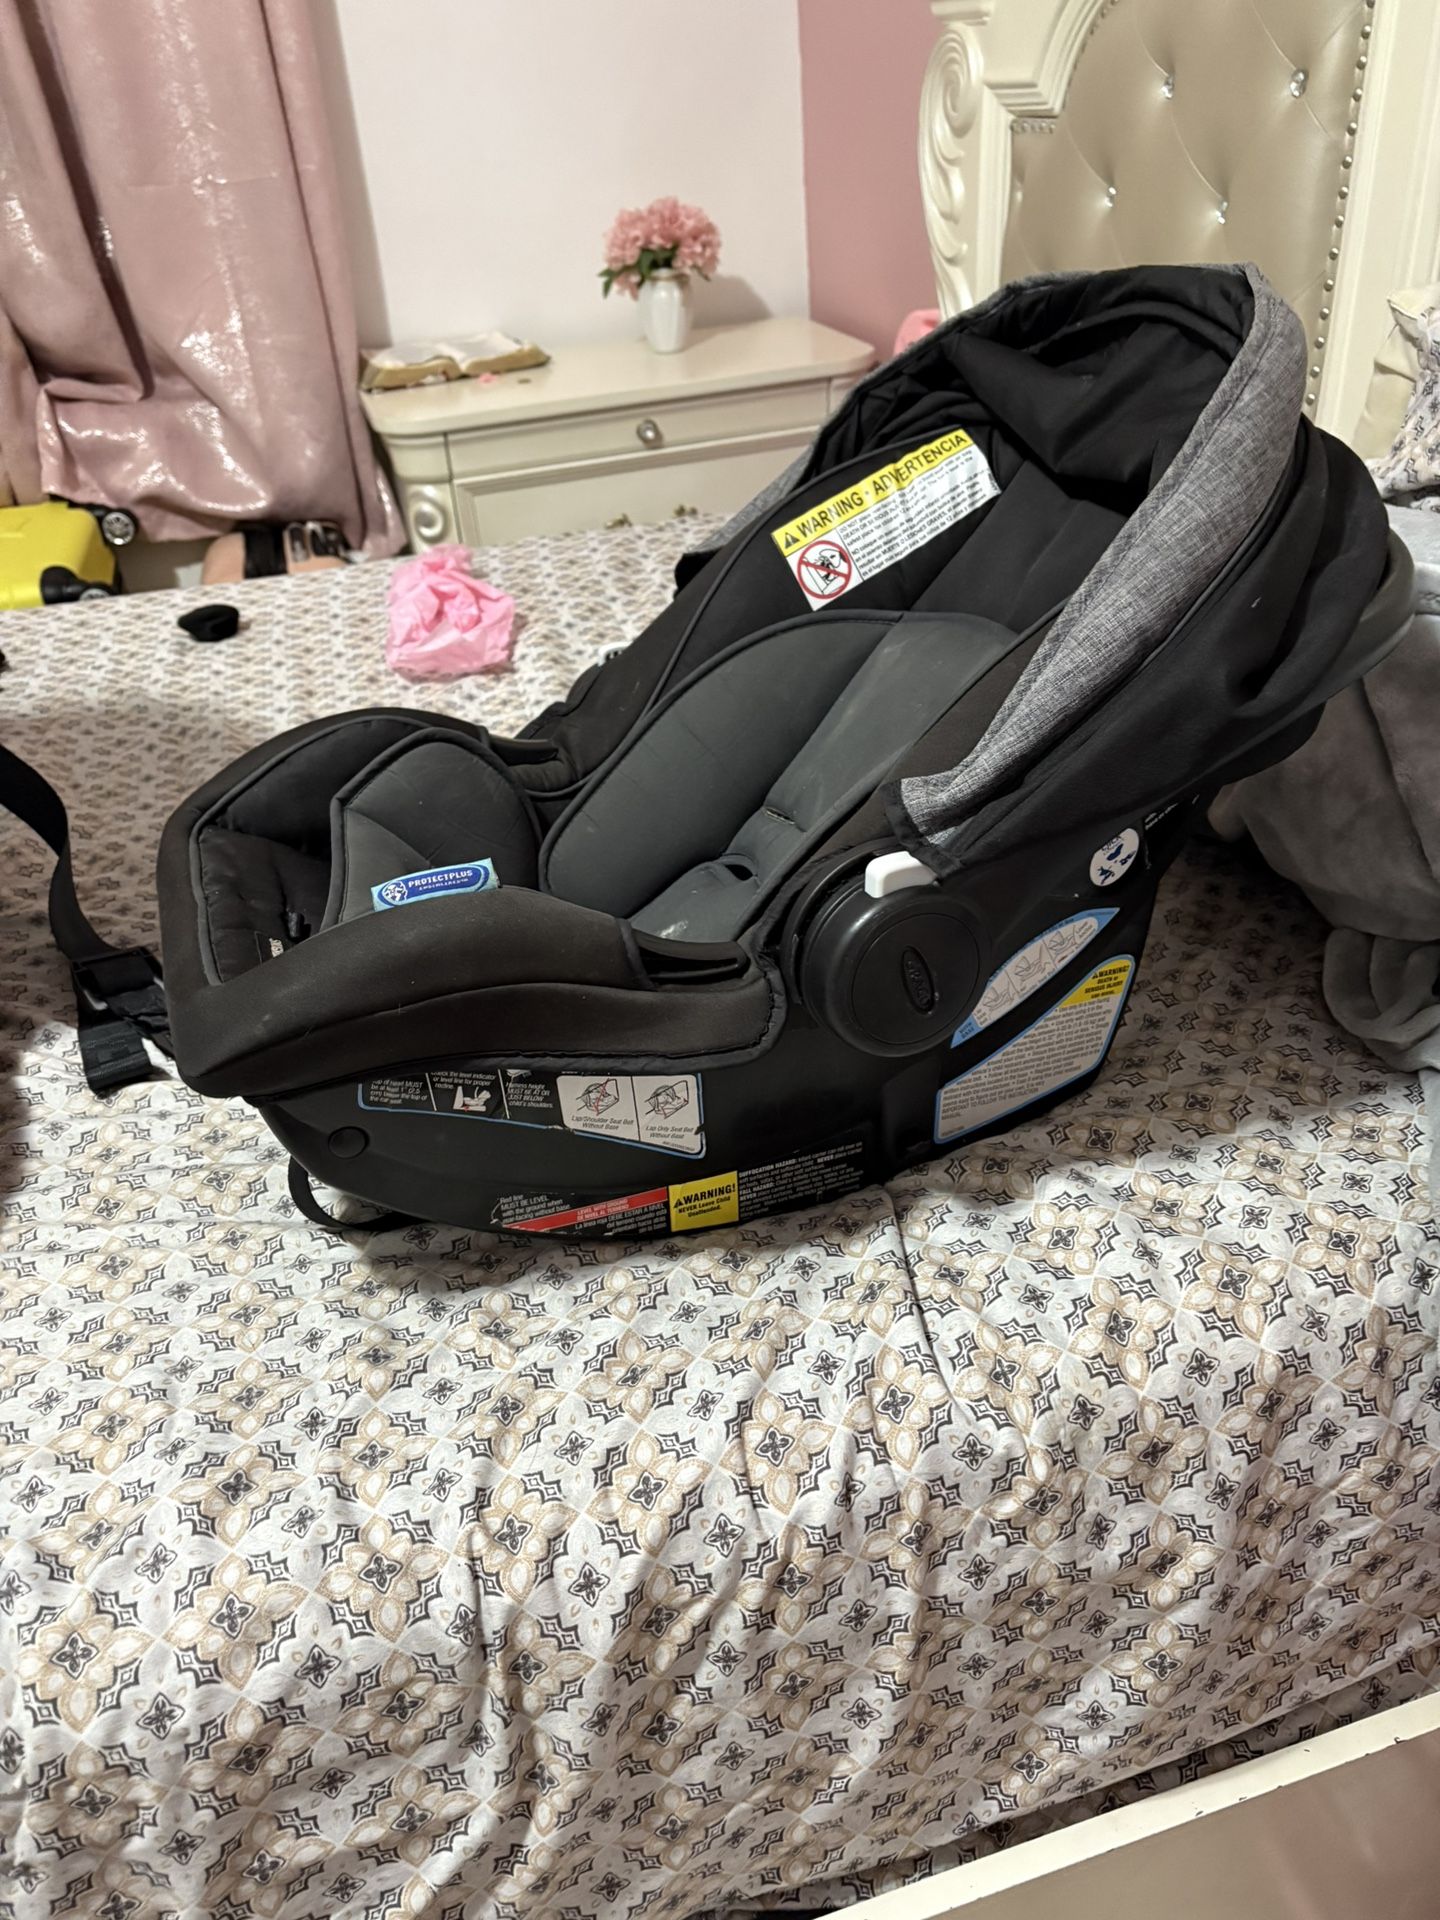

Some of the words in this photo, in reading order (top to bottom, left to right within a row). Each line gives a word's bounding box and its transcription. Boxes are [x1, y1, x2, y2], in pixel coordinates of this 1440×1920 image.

[796, 490, 864, 538] WARNING
[873, 433, 967, 496] ADVERTENCIA
[1098, 964, 1130, 977] WARNING!
[683, 1183, 735, 1205] WARNING!
[687, 1204, 722, 1217] Unattended.
